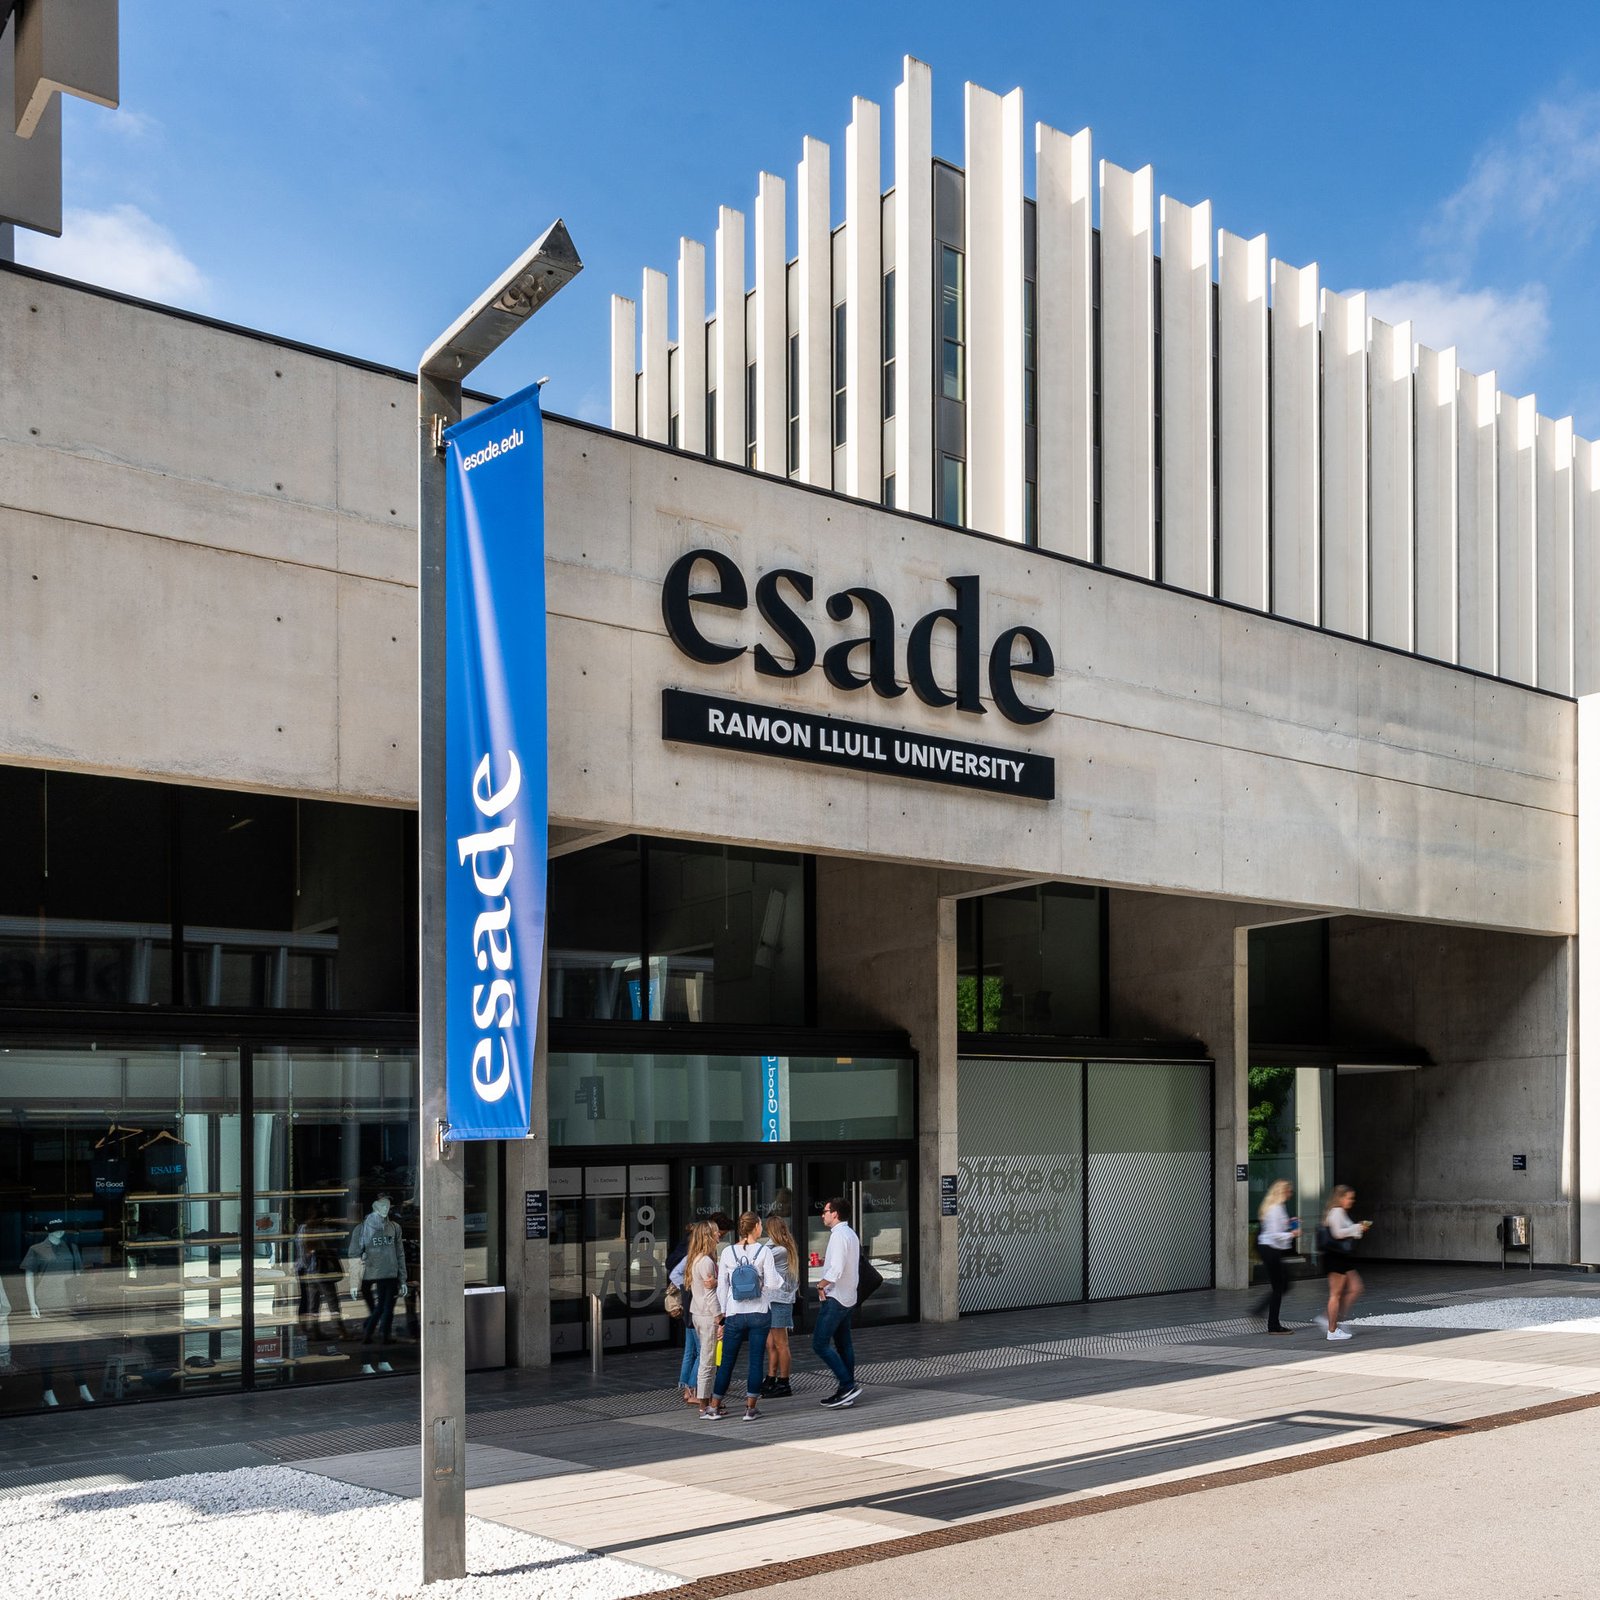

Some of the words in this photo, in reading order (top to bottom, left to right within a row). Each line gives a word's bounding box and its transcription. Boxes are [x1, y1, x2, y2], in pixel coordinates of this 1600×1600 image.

[463, 428, 524, 471] esade.edu
[662, 549, 1055, 725] esade
[708, 708, 811, 748] RAMON
[820, 728, 887, 760] LLULL
[894, 740, 1025, 783] UNIVERSITY
[457, 749, 521, 1102] esade
[151, 1165, 182, 1175] ESADE
[756, 1200, 783, 1211] esade
[871, 1194, 896, 1206] esade
[257, 1343, 276, 1353] OUTLET
